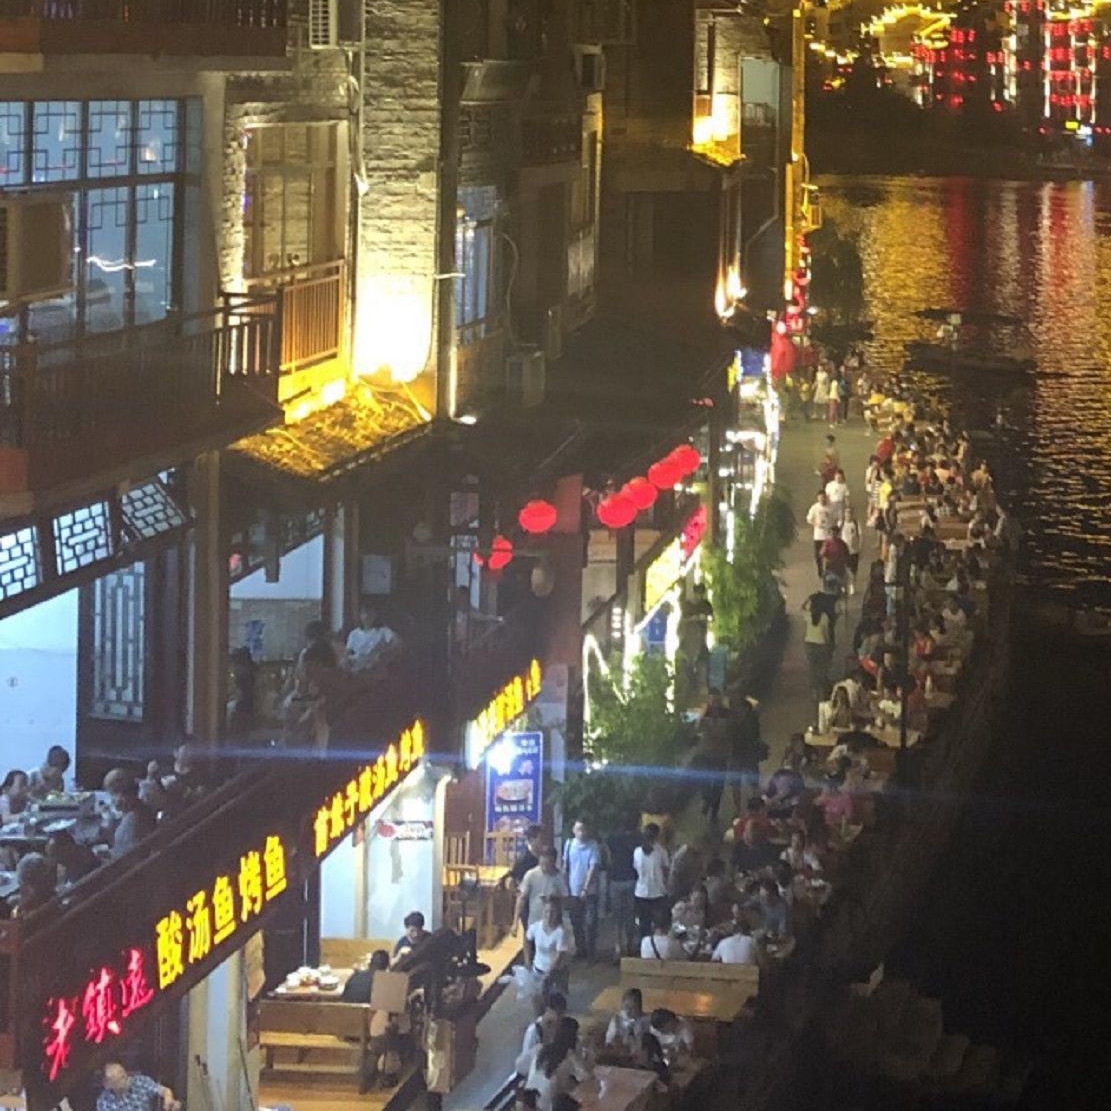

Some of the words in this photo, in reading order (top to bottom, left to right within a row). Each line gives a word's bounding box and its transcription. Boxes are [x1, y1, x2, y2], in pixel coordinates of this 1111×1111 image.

[155, 835, 287, 989] 酸汤鱼烤鱼
